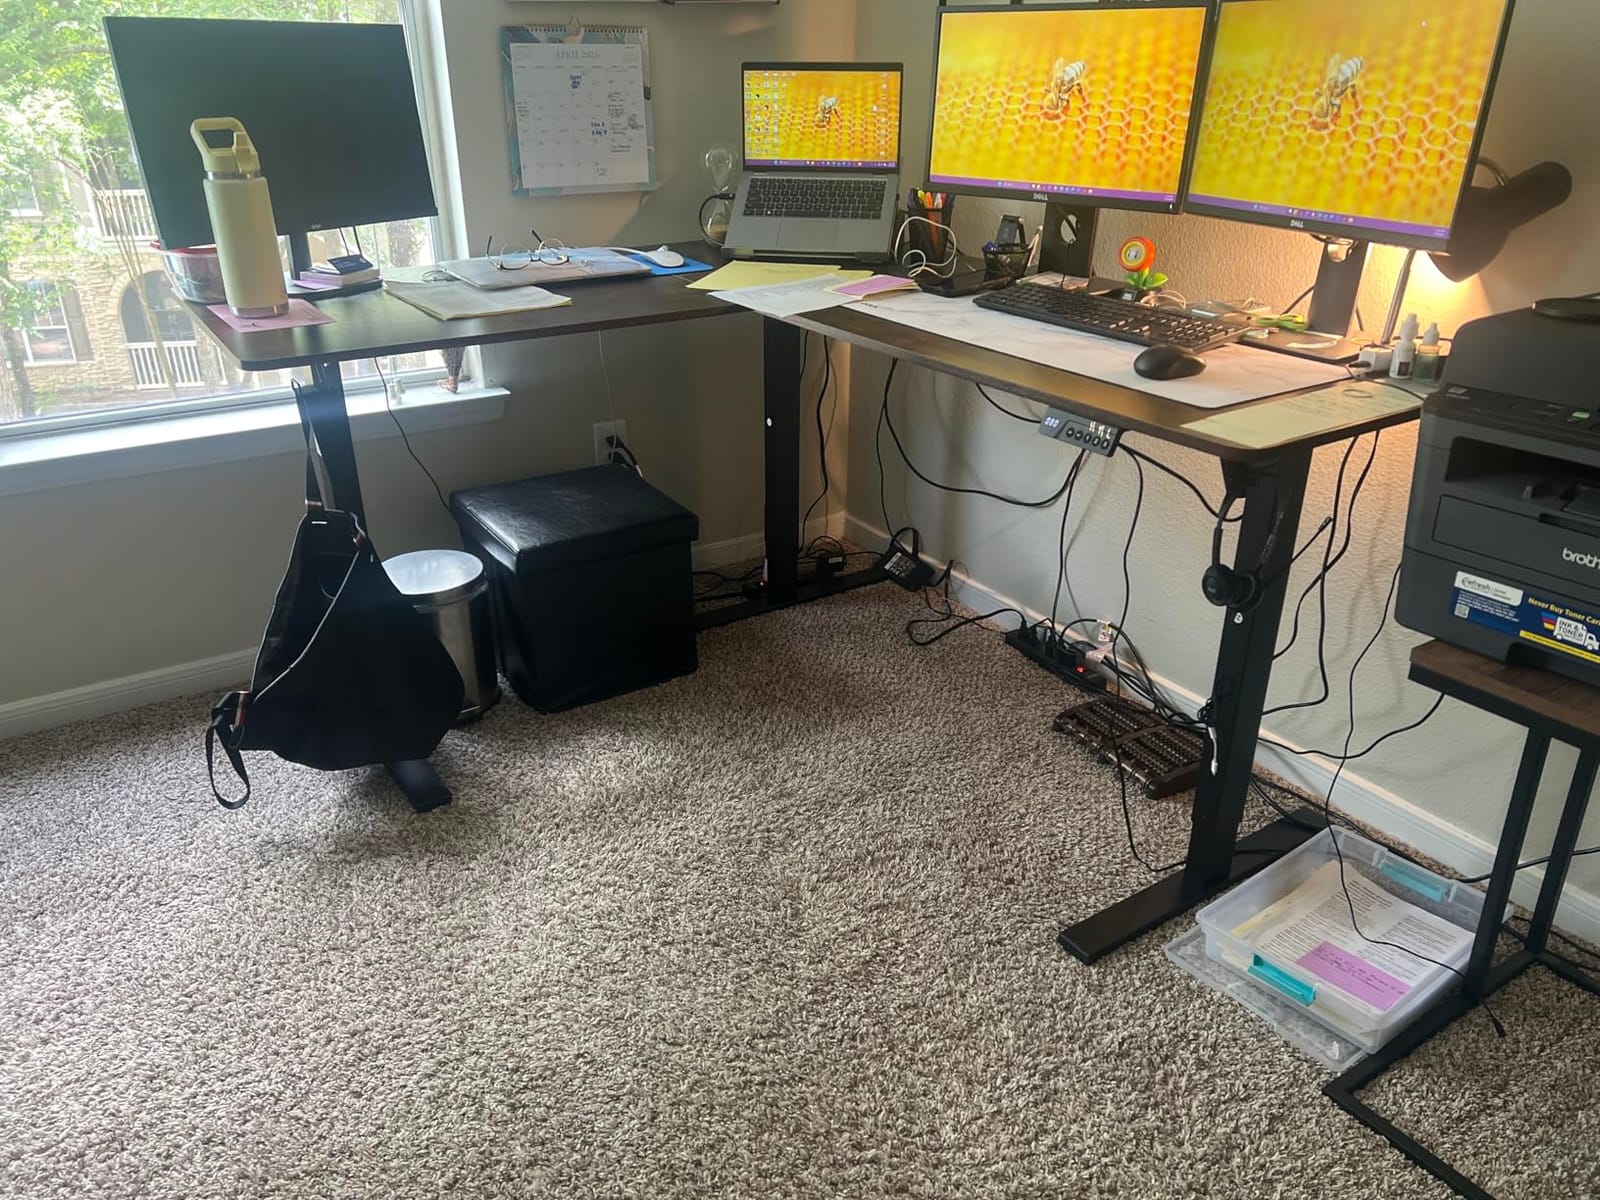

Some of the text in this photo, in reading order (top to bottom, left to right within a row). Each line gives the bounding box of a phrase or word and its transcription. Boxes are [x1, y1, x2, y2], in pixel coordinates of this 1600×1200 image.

[554, 50, 579, 60] APRIL
[1033, 192, 1049, 201] DELL
[1289, 219, 1304, 228] DELL
[1528, 597, 1600, 626] Never Buy Toner Car
[1559, 619, 1573, 629] INK
[1559, 626, 1583, 638] TONER
